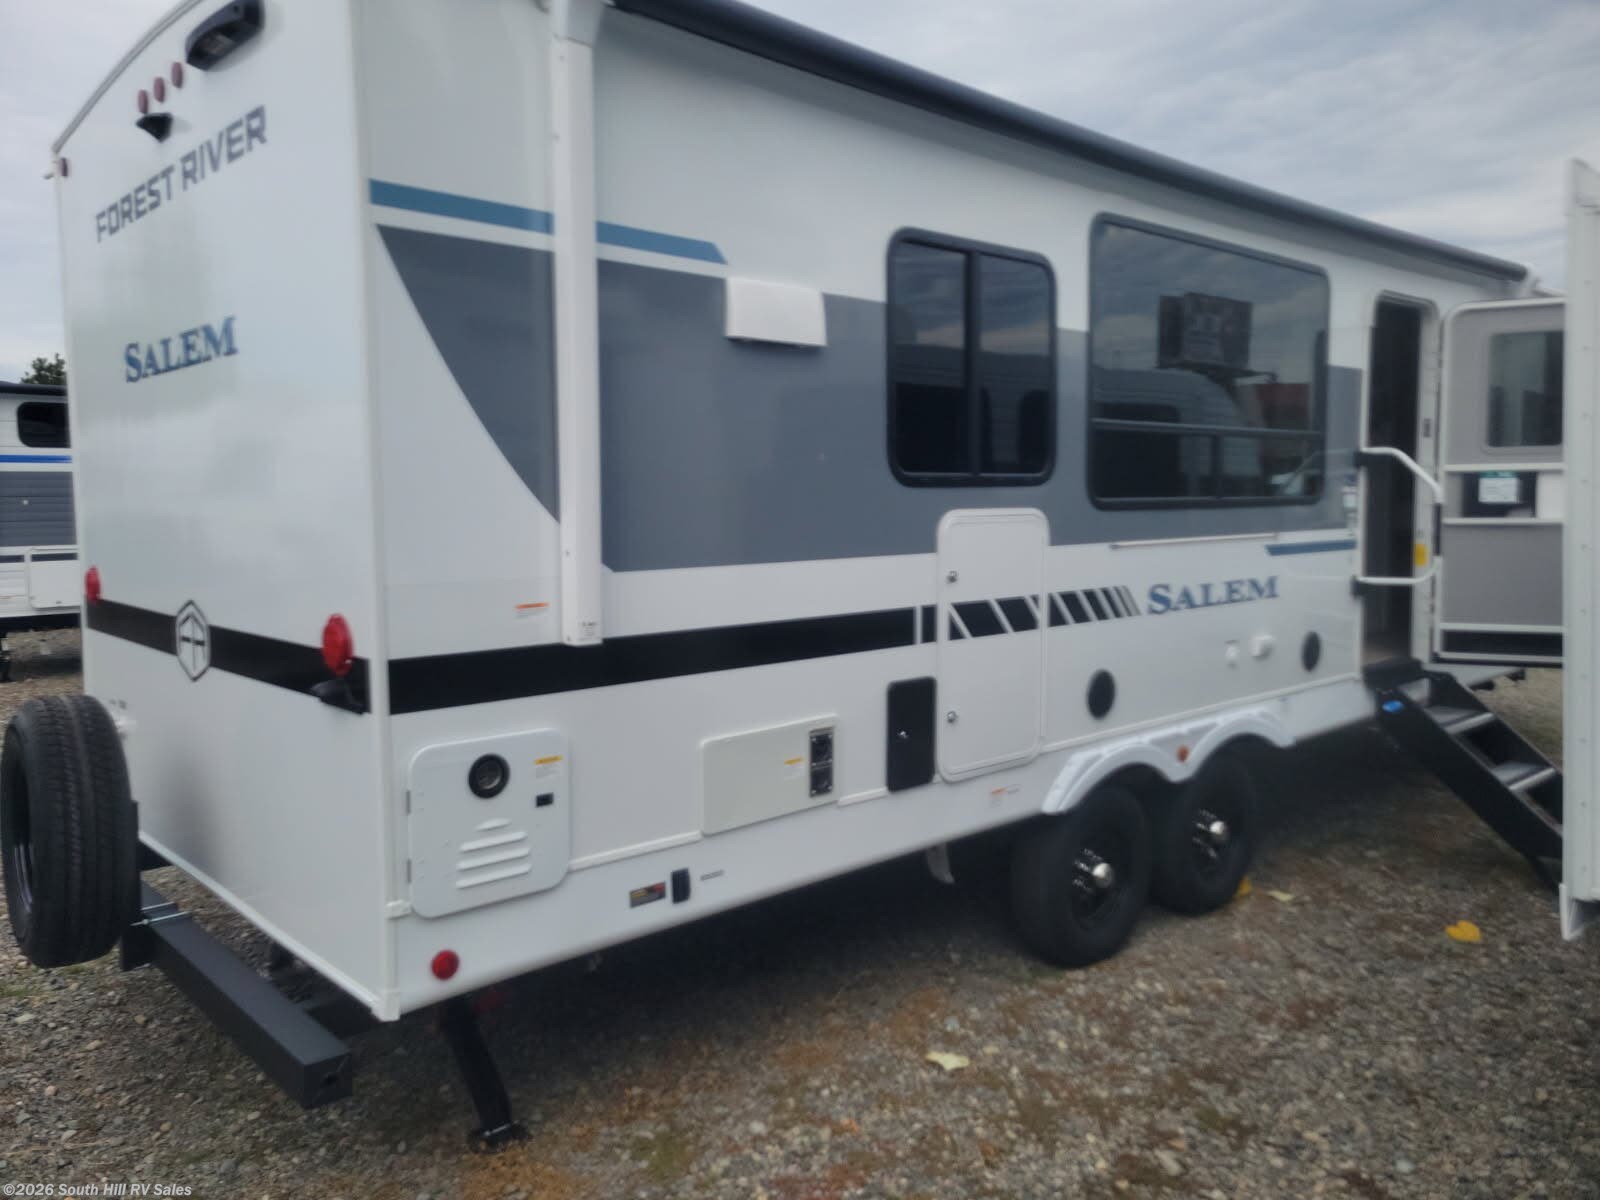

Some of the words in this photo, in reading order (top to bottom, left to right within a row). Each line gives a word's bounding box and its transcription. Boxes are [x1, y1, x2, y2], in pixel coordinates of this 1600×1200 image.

[95, 164, 175, 243] FOREST
[180, 104, 267, 191] RIVER
[124, 315, 238, 383] SALEM
[1148, 575, 1279, 615] SALEM
